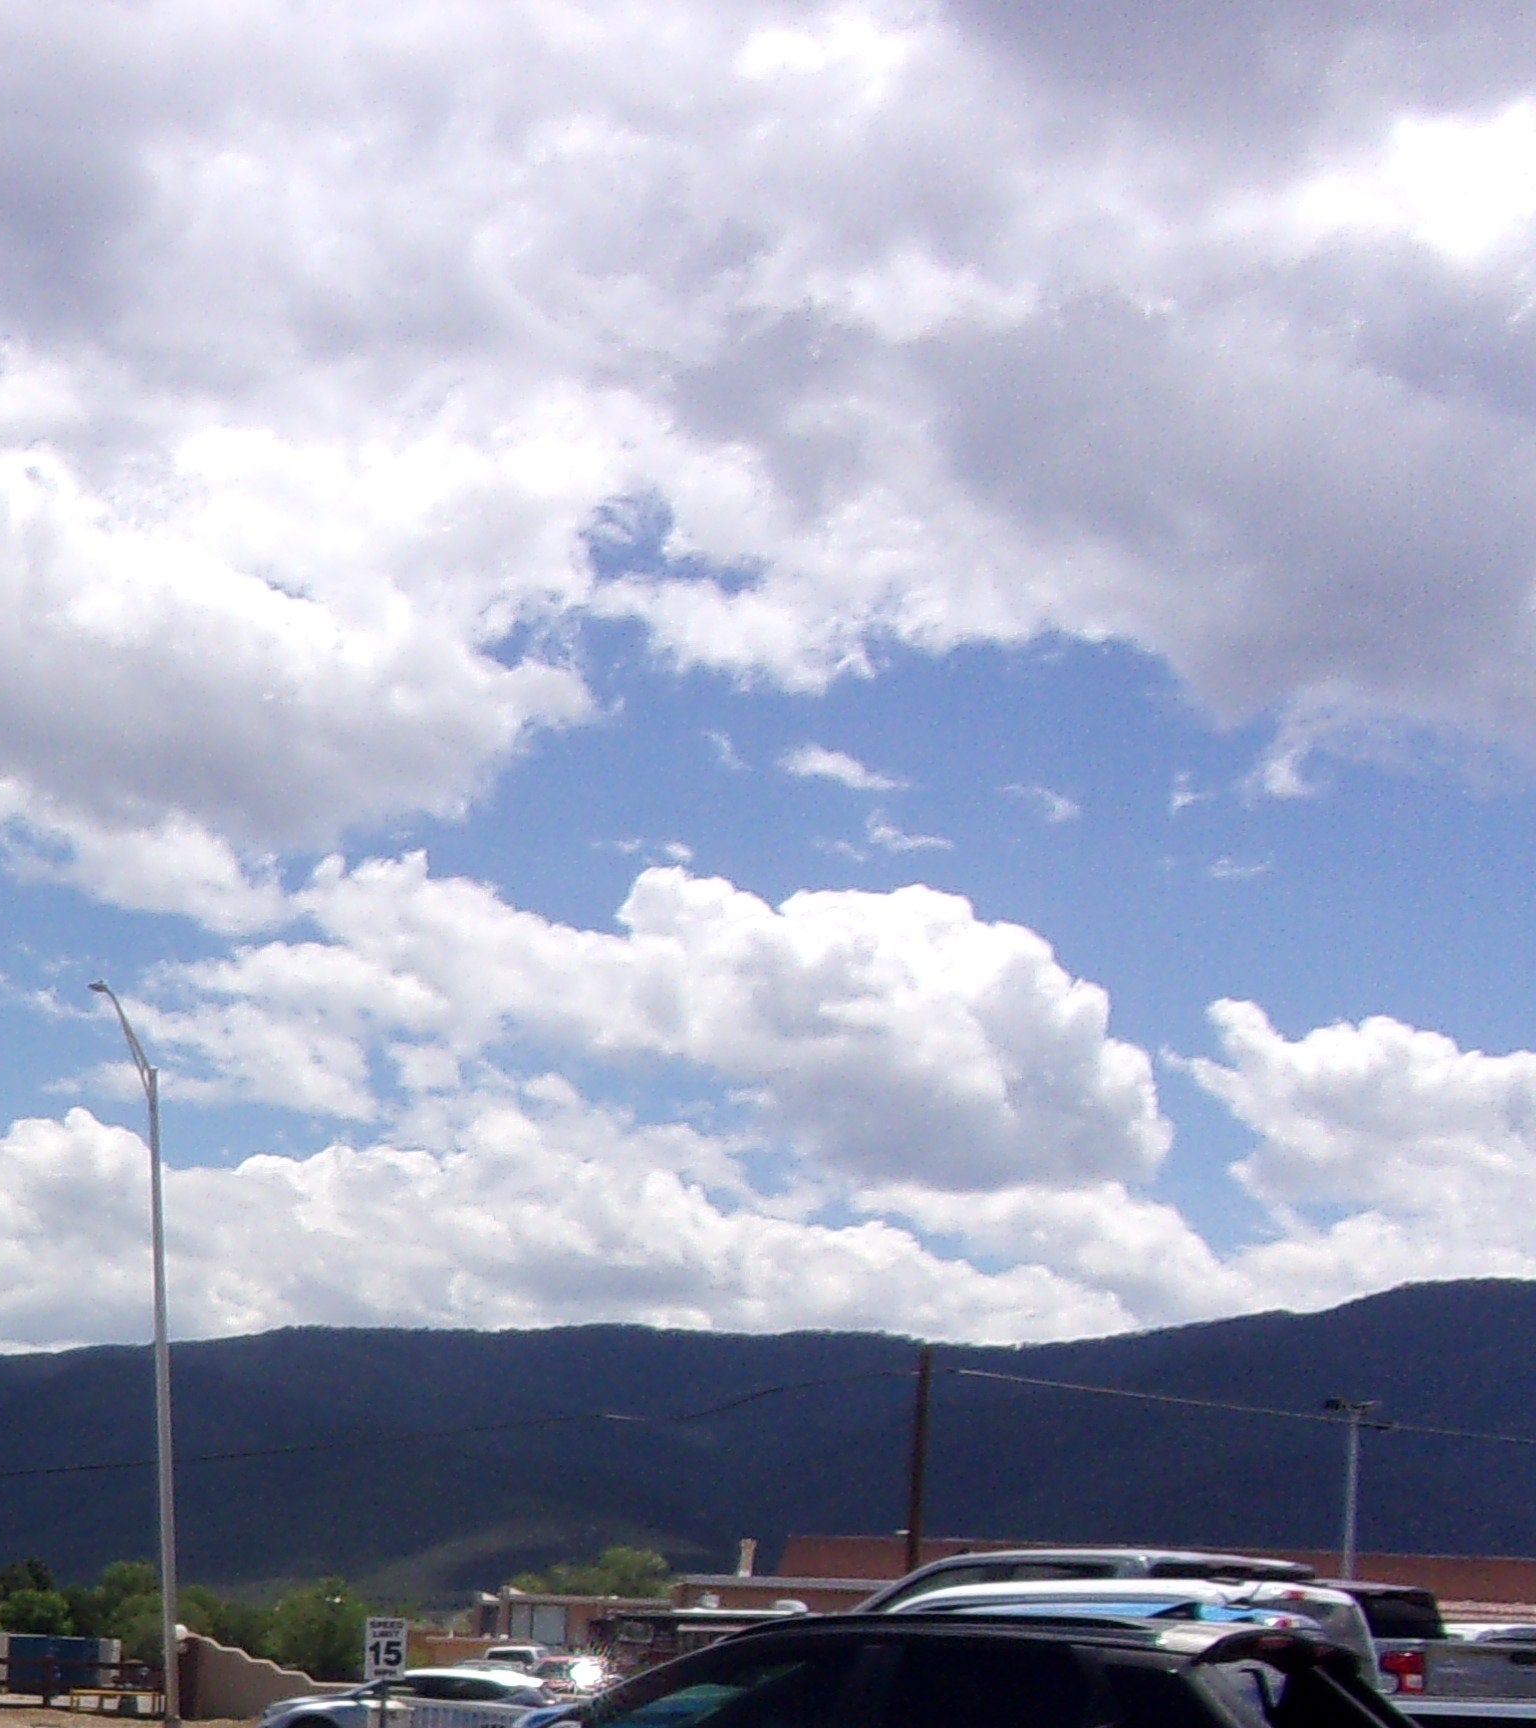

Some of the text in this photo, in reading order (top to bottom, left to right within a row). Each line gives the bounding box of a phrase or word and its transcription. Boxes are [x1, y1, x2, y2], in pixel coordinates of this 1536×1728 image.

[369, 1620, 404, 1629] SPEED
[372, 1630, 400, 1638] LIMIT
[369, 1640, 402, 1667] 15
